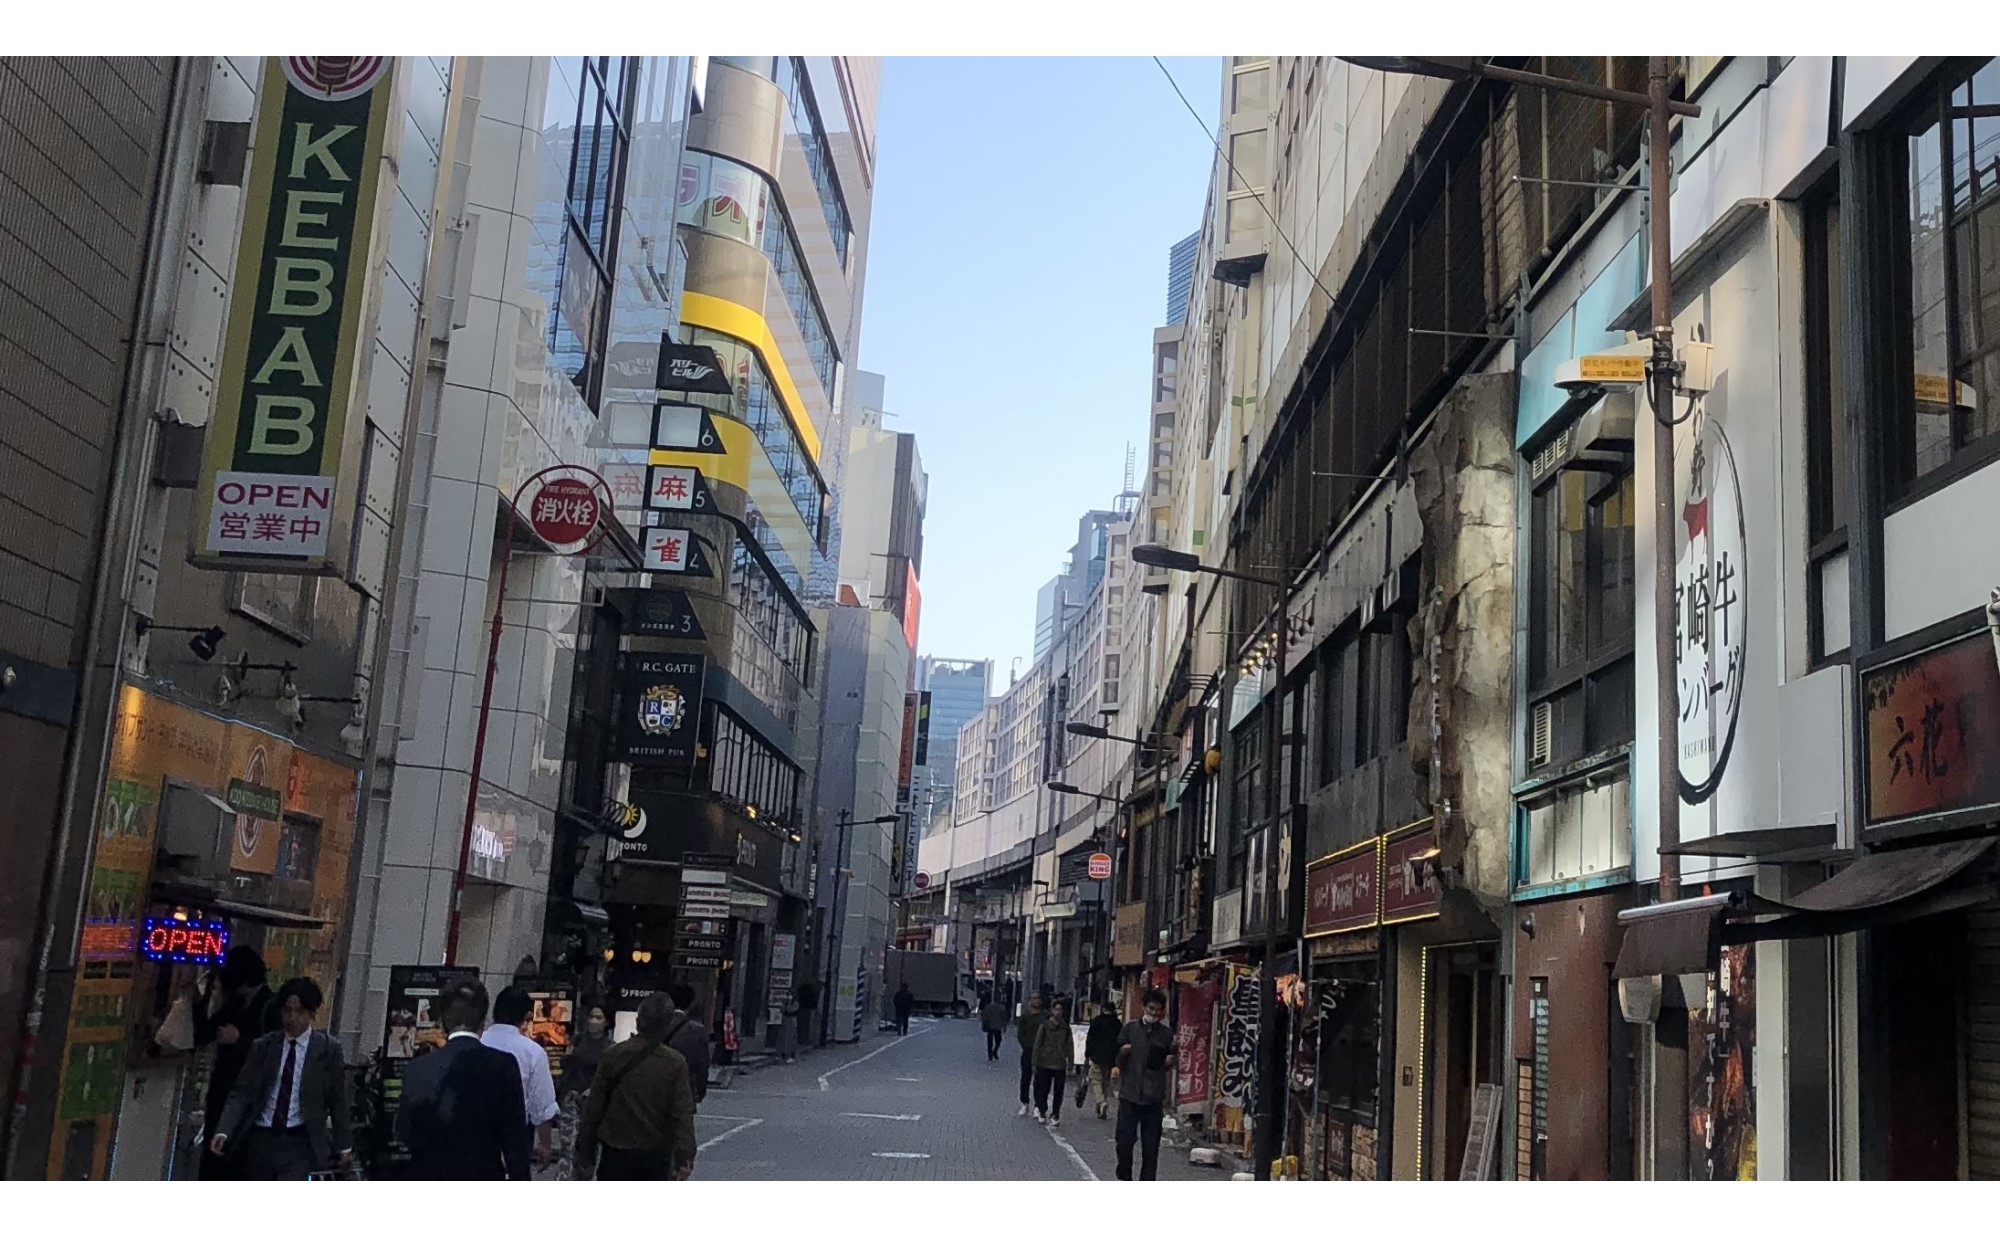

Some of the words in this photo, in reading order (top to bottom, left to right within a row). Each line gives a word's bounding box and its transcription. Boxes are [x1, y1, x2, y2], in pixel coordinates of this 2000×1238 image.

[246, 122, 358, 455] KEBAB
[701, 428, 714, 447] 6
[217, 481, 331, 510] OPEN
[545, 484, 560, 494] FIRE
[561, 485, 591, 497] HYDRANT
[654, 474, 689, 502] 麻
[694, 490, 706, 508] 5
[535, 496, 595, 527] 消火栓
[218, 511, 322, 544] 営業中
[651, 536, 683, 564] 雀
[680, 614, 692, 633] 3
[664, 663, 697, 674] GATE
[1682, 645, 1740, 723] ンバーグ
[628, 746, 665, 755] BRITISH
[1089, 865, 1110, 873] KING
[149, 926, 223, 955] OPEN
[688, 940, 721, 949] PRONTO
[686, 957, 720, 966] PRONTO
